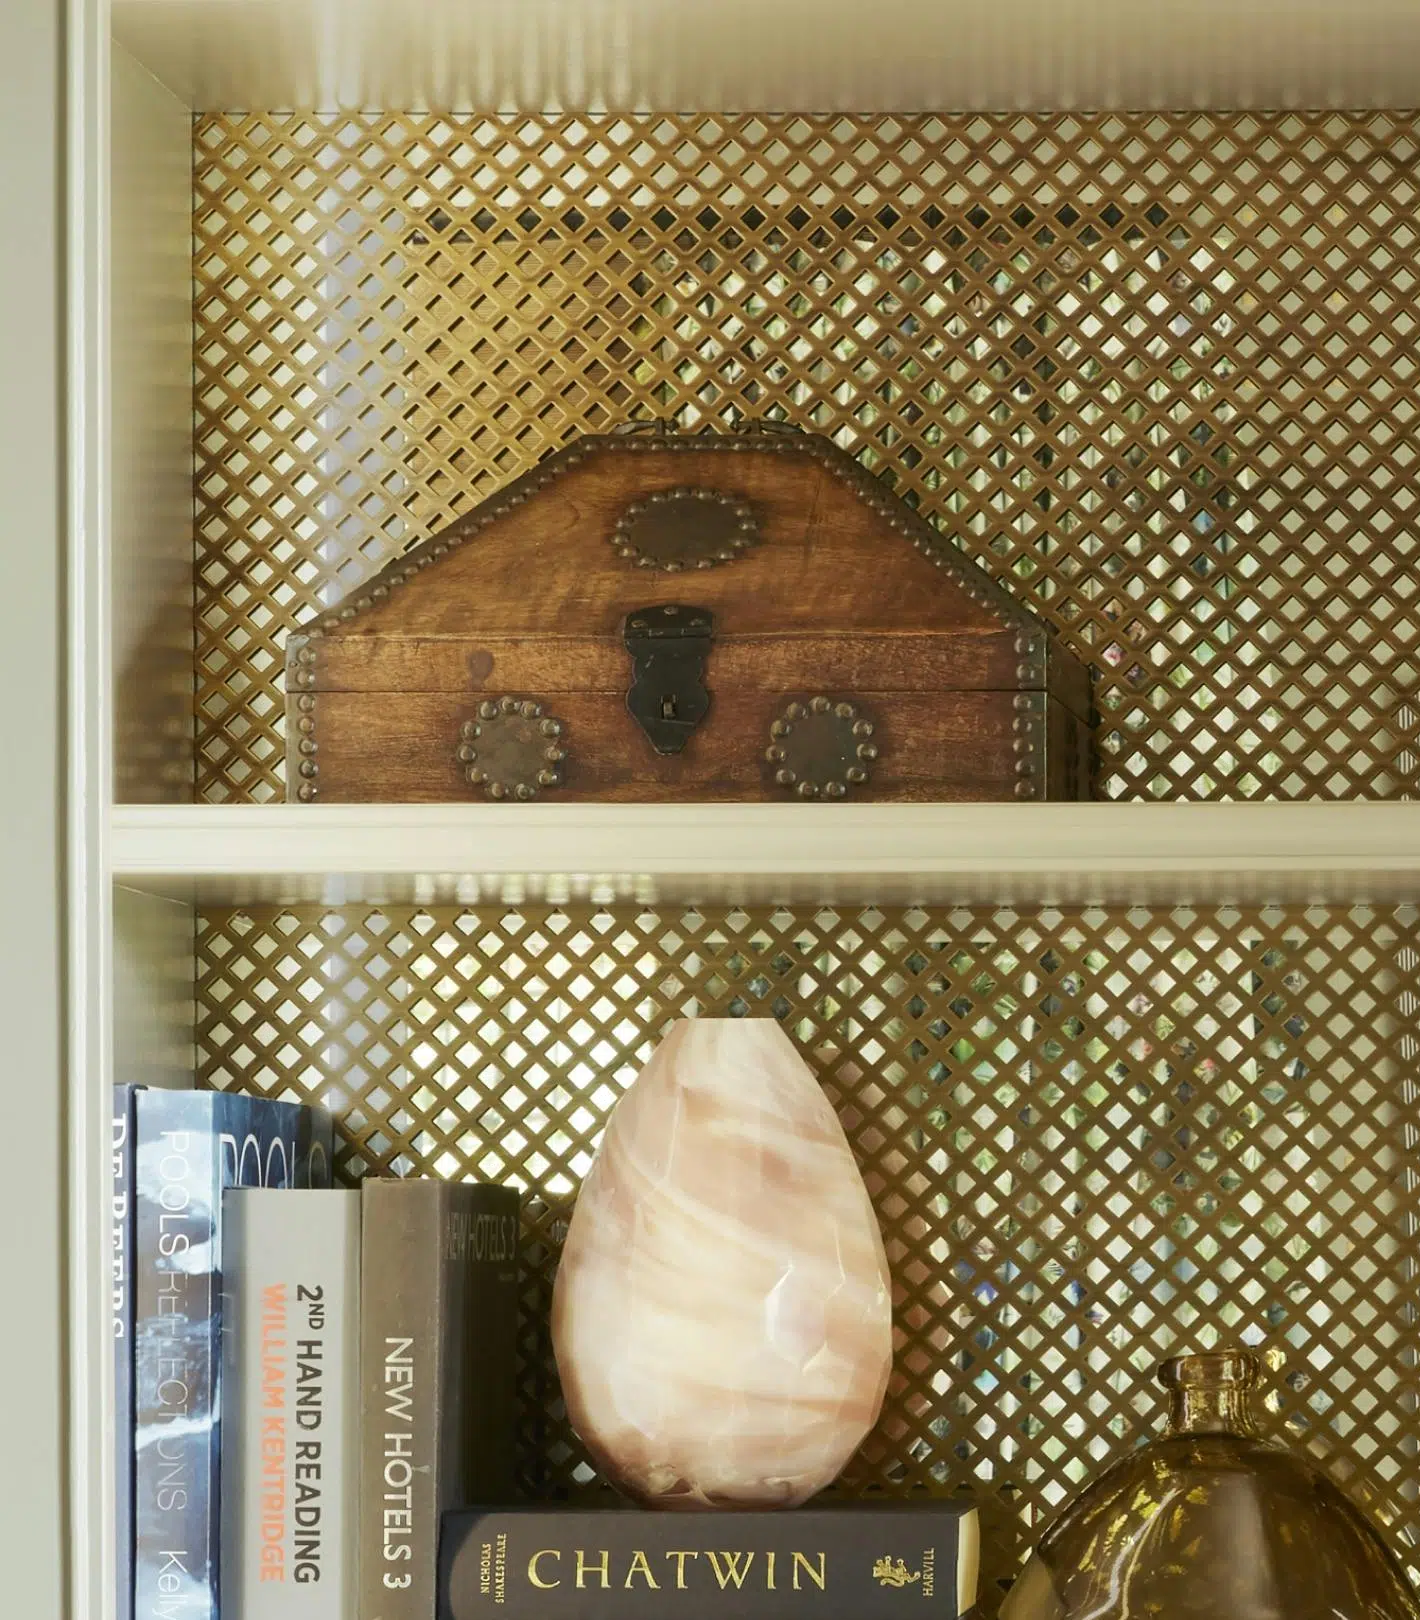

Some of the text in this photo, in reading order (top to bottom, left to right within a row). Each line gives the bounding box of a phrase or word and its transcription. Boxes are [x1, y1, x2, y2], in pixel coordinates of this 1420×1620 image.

[159, 1131, 190, 1256] POOLS
[259, 1283, 287, 1584] WILLIAM KENTRIDGE
[293, 1284, 324, 1584] 2ND HAND READING
[382, 1337, 414, 1589] NEW HOTELS 3
[480, 1543, 491, 1594] NICHOLAS
[495, 1533, 507, 1603] SHAKESPEARE
[527, 1549, 826, 1590] CHATWIN
[922, 1548, 934, 1597] HARVILL
